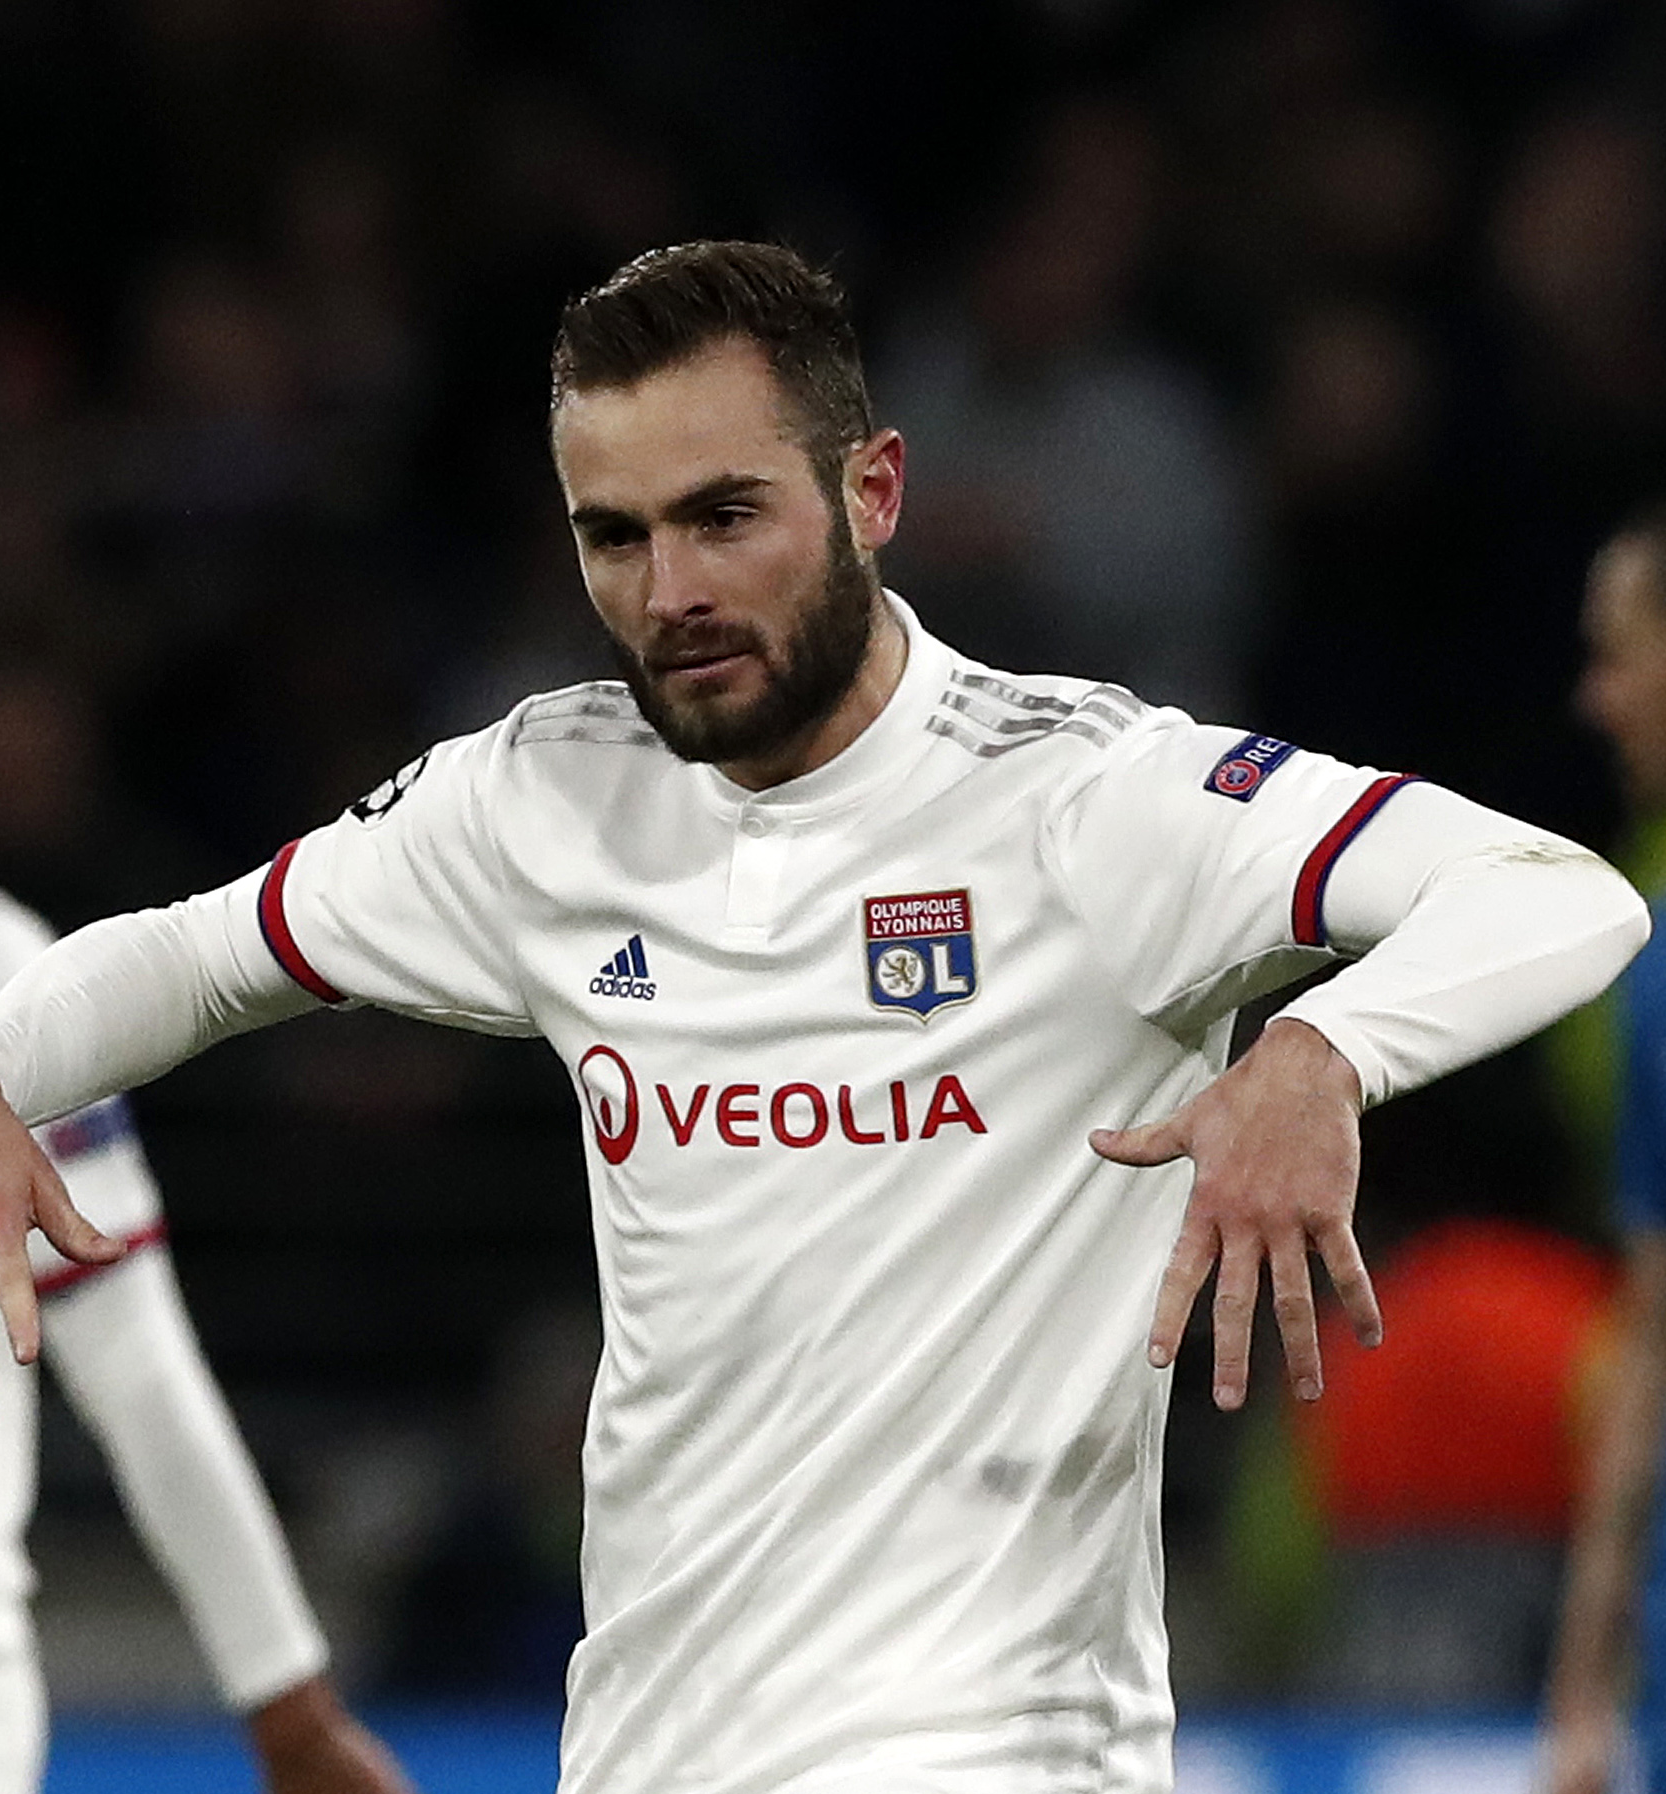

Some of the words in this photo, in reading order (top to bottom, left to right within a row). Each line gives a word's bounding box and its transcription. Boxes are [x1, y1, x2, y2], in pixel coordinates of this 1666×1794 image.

[1244, 736, 1289, 764] RE
[870, 897, 963, 919] OLYMPIQUE
[872, 914, 965, 935] LYONNAIS
[589, 974, 657, 1001] adidas
[655, 1073, 989, 1149] VEOLIA
